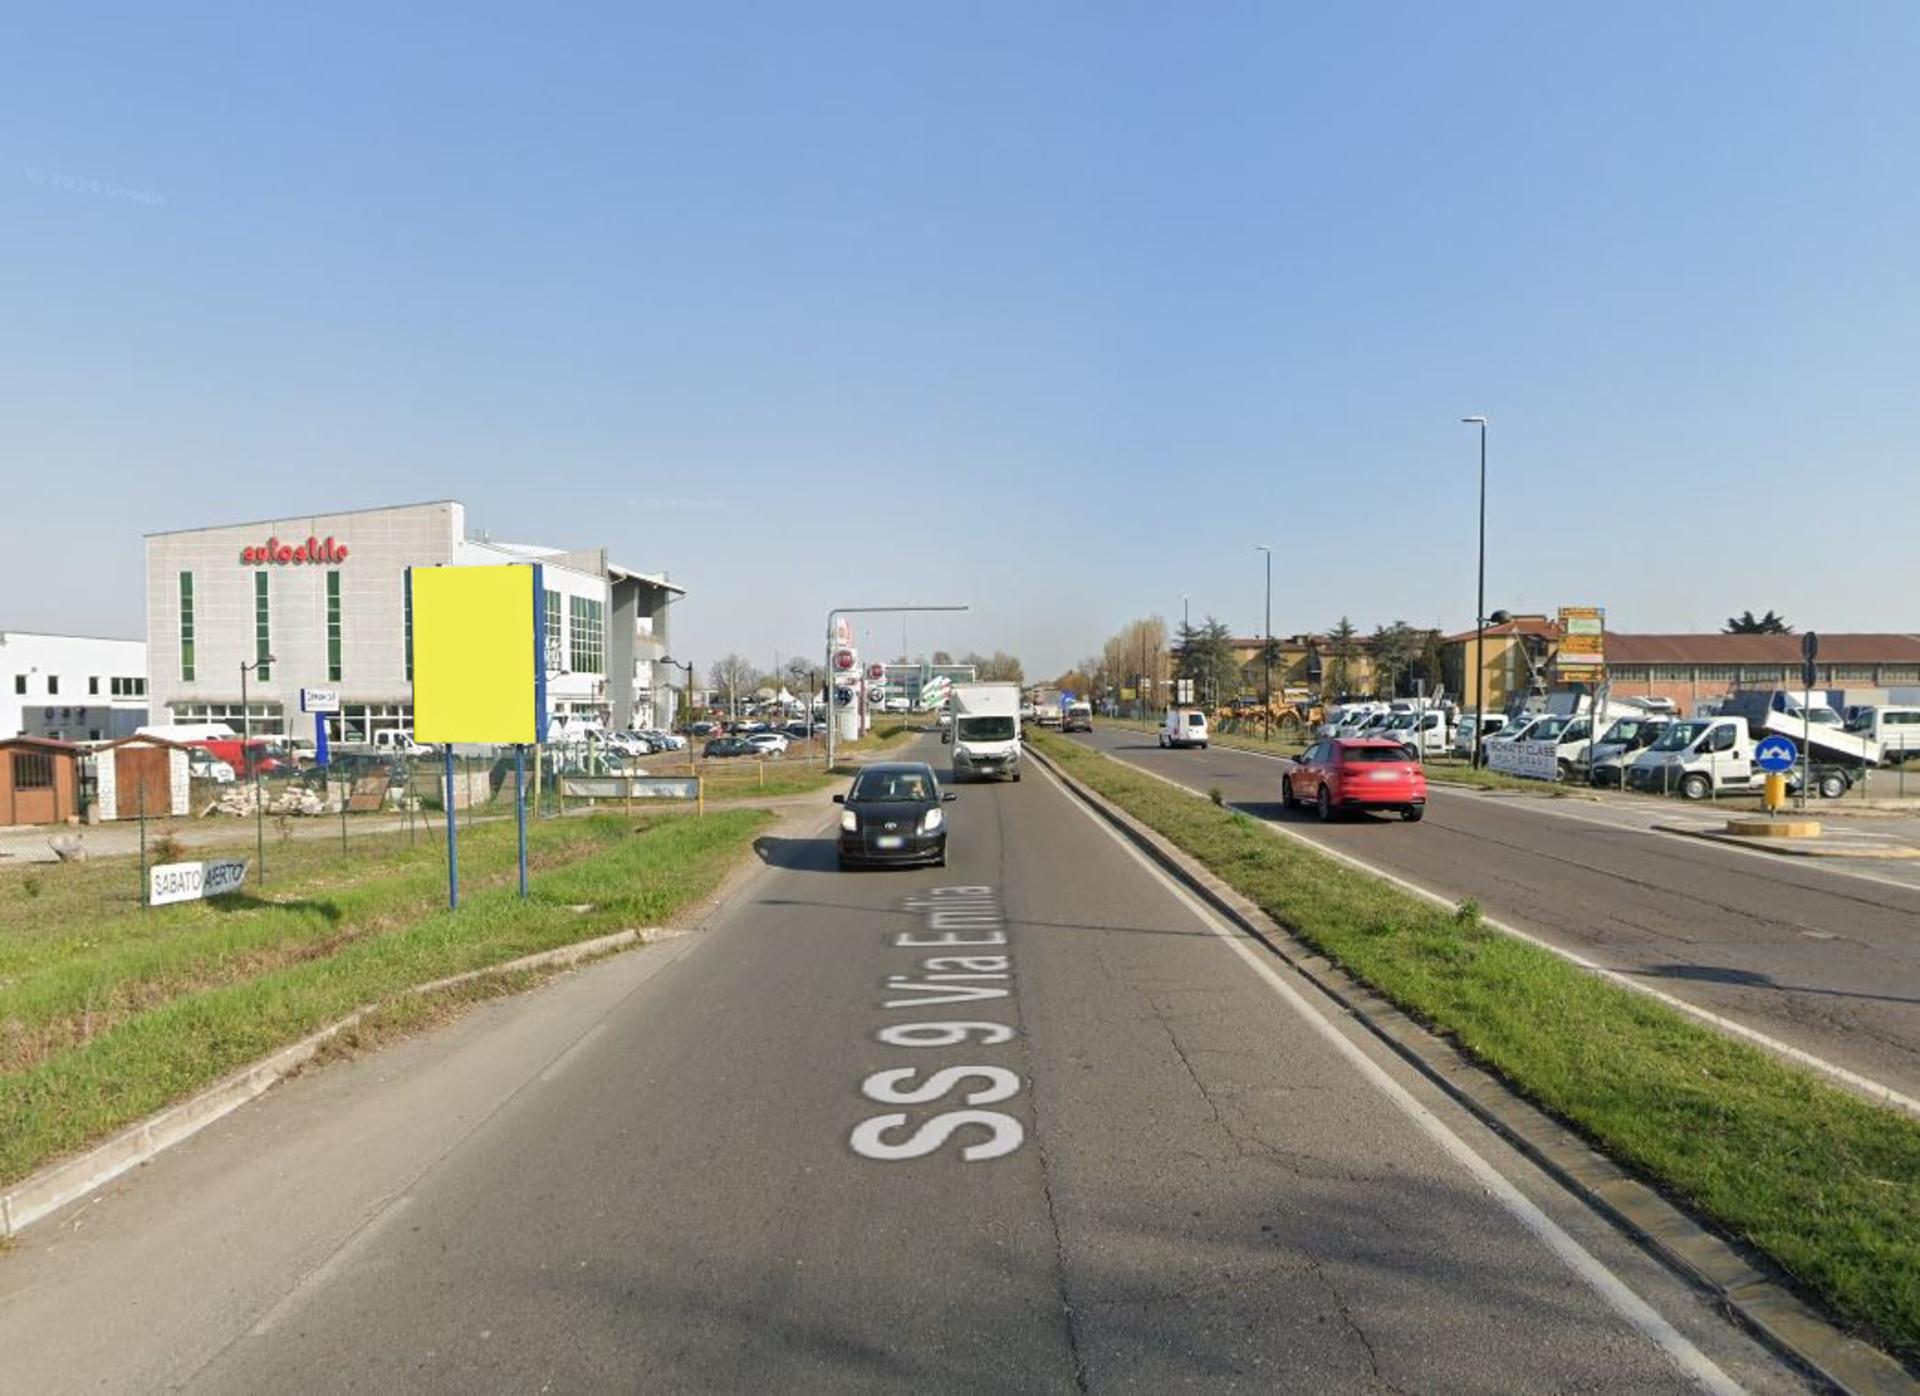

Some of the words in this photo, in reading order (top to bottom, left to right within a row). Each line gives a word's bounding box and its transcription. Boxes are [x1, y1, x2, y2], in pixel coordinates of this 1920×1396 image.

[241, 537, 348, 564] autostile
[155, 869, 201, 896] SABATO
[204, 863, 244, 889] APERTO
